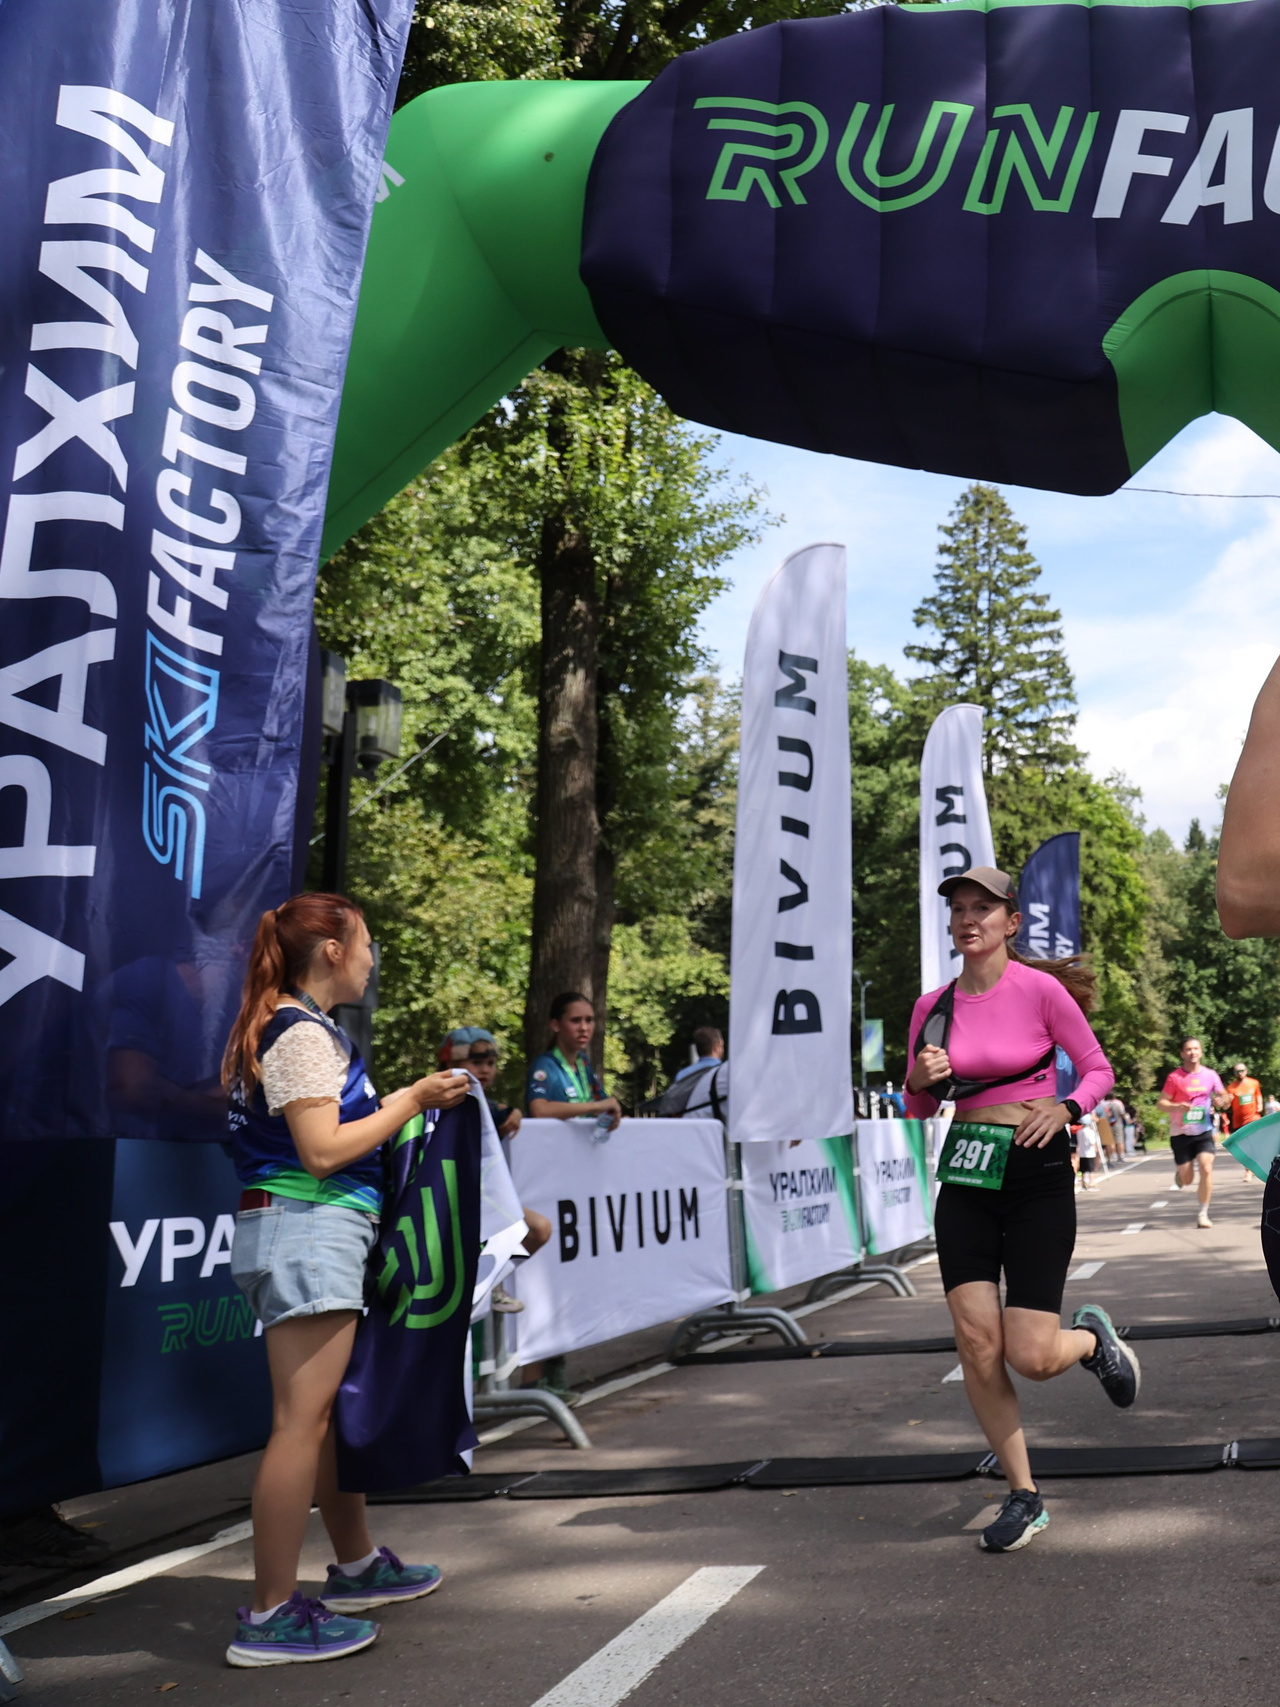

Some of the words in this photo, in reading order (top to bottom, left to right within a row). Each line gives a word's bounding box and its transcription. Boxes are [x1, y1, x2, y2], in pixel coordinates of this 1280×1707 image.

[771, 649, 822, 1035] BIVIUM
[949, 1139, 996, 1172] 291
[769, 1166, 837, 1203] УРАЛХИМ
[557, 1187, 700, 1264] BIVIUM
